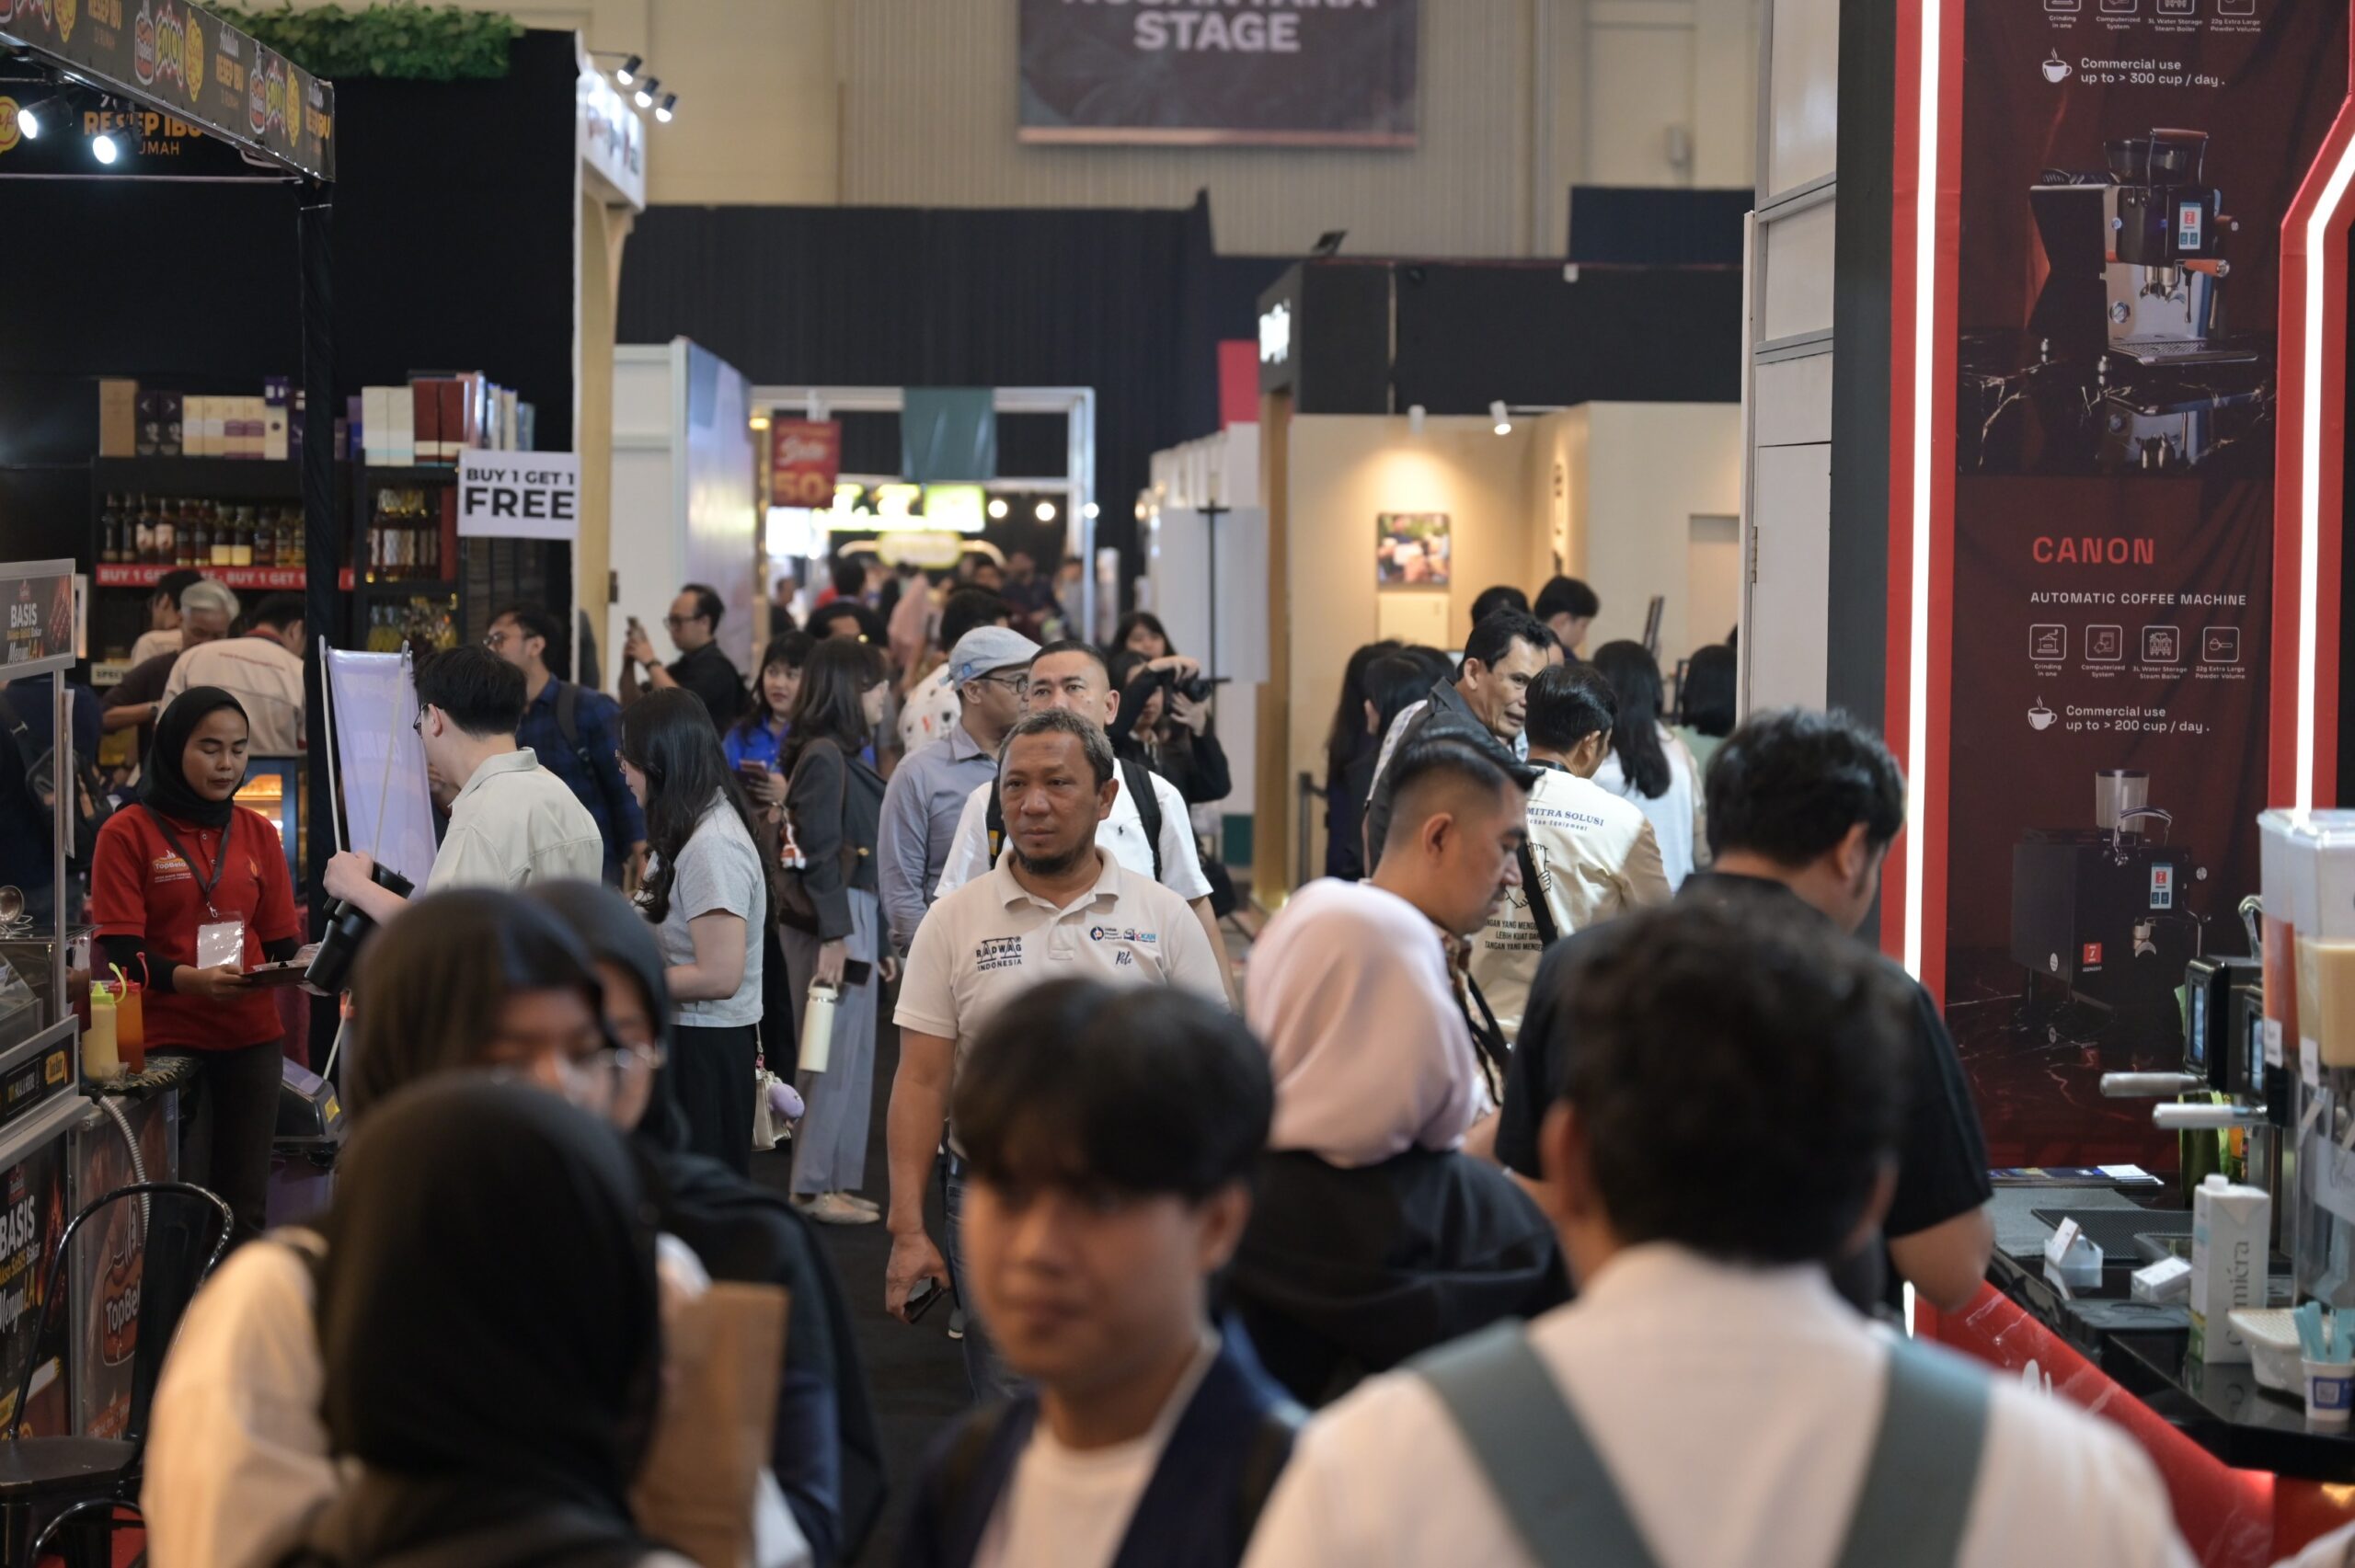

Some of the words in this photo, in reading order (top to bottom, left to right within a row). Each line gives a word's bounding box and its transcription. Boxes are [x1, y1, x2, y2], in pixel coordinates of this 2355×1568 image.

[1132, 11, 1301, 52] STAGE
[2081, 57, 2155, 69] Commercial
[2159, 61, 2181, 70] use
[2081, 74, 2097, 85] up
[2101, 73, 2115, 84] to
[2130, 73, 2155, 84] 300
[2158, 74, 2183, 86] cup
[2194, 74, 2219, 87] day
[466, 468, 505, 483] BUY
[511, 470, 519, 484] 1
[525, 470, 561, 486] GET
[568, 473, 574, 486] 1
[465, 486, 574, 520] FREE
[2032, 537, 2154, 564] CANON
[100, 568, 128, 581] BUY
[132, 569, 139, 581] 1
[227, 572, 255, 585] BUY
[258, 573, 266, 585] 1
[269, 573, 296, 586] GET
[2030, 592, 2116, 604] AUTOMATIC
[2120, 593, 2176, 604] COFFEE
[2180, 593, 2247, 606] MACHINE
[11, 603, 37, 628] BASIS
[2066, 704, 2141, 716] Commercial
[2144, 708, 2166, 717] use
[2066, 721, 2083, 732] up
[2086, 720, 2100, 730] to
[2115, 720, 2140, 731] 200
[2142, 722, 2167, 733] cup
[2179, 720, 2203, 734] day
[1527, 807, 1563, 818] MITRA
[1565, 811, 1604, 827] SOLUSI
[1502, 921, 1517, 929] YANG
[1496, 931, 1512, 939] LEBIH
[1513, 932, 1528, 940] KUAT
[976, 944, 1022, 957] RADWAG
[1485, 941, 1506, 950] TANGAN
[977, 959, 1022, 972] INDONESIA
[0, 1195, 35, 1261] BASIS
